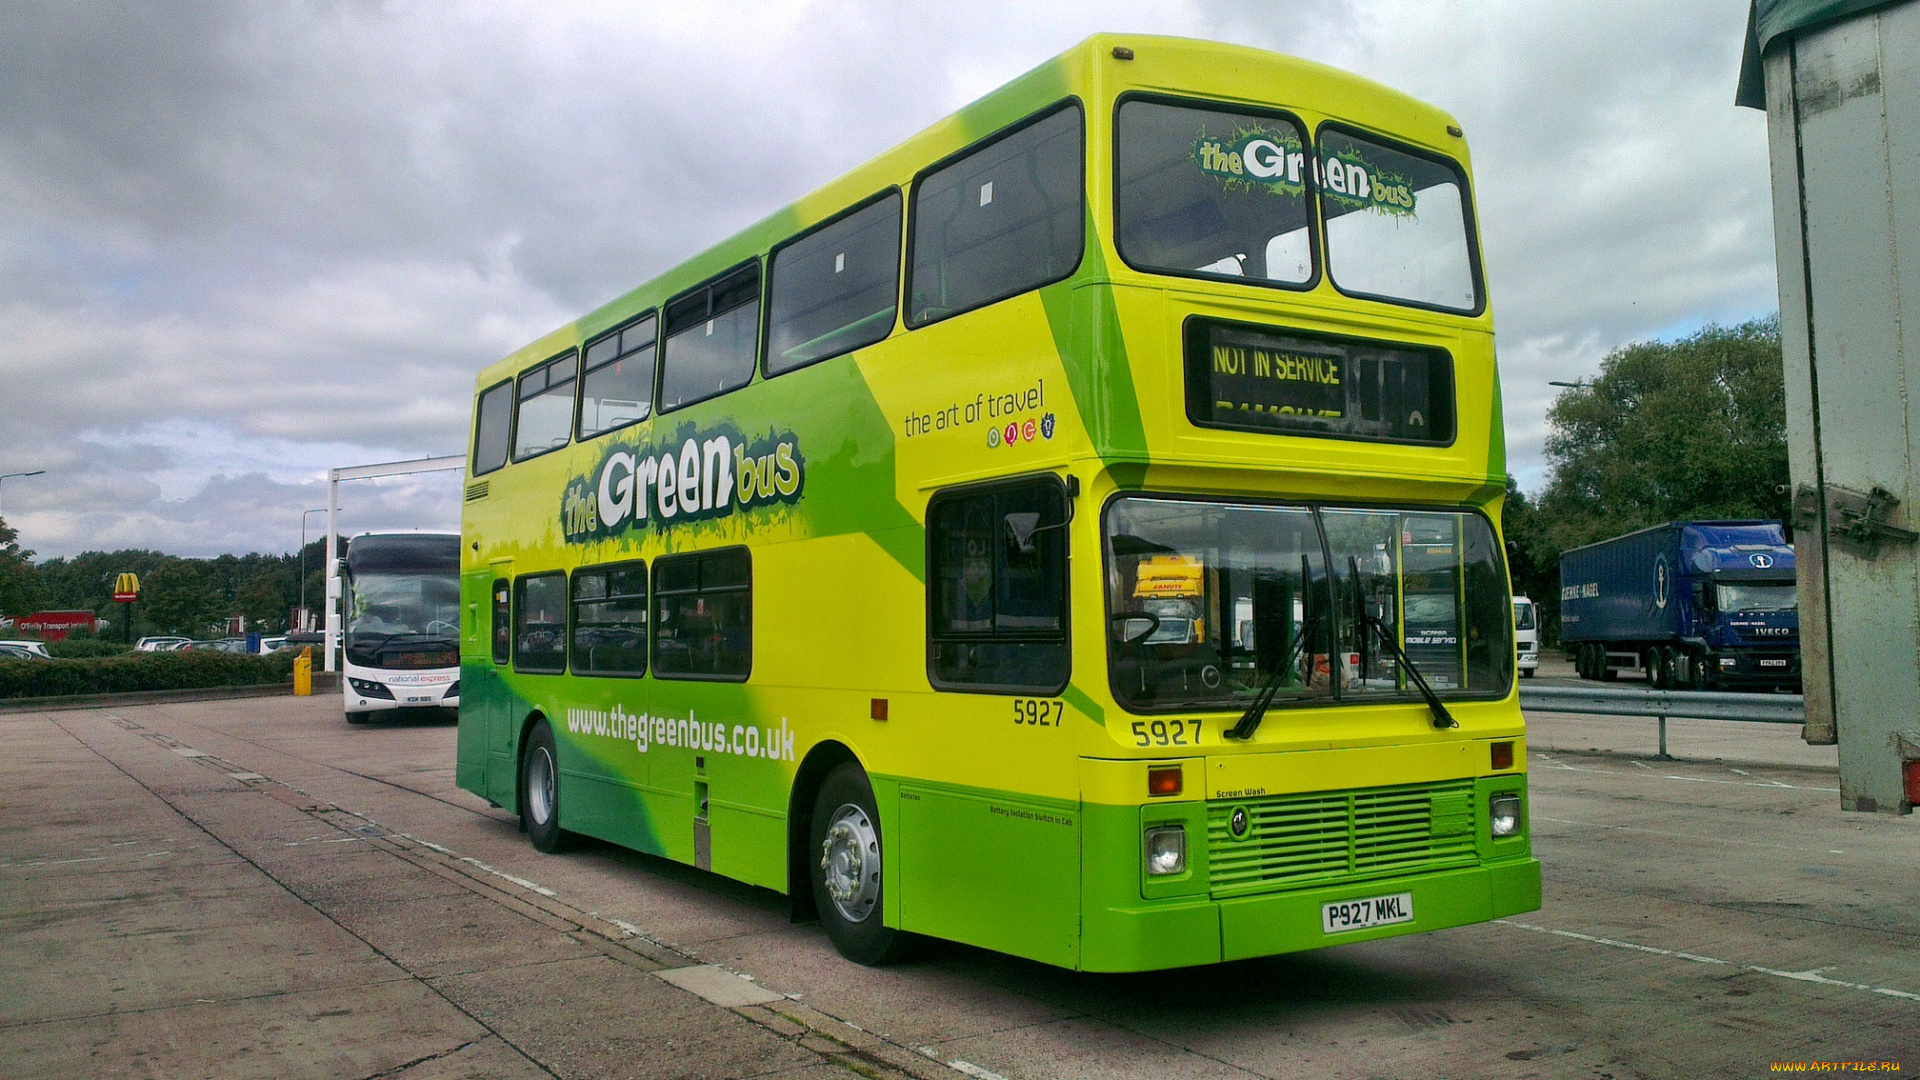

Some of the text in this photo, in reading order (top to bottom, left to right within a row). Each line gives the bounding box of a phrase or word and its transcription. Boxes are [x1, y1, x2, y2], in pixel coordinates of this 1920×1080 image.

[1200, 142, 1243, 175] the
[1370, 175, 1414, 208] bus
[1213, 346, 1340, 385] NOT IN SERVICE
[905, 379, 1044, 437] the art of travel
[566, 435, 800, 535] the Green bus
[43, 622, 69, 631] Transport
[1013, 699, 1064, 727] 5927
[567, 703, 796, 762] www.thegreenbus.co.uk
[1131, 719, 1203, 747] 5927
[1216, 787, 1266, 798] Screen Wash
[990, 806, 1010, 817] Battery
[1010, 809, 1034, 820] Isolation
[1034, 812, 1054, 823] Switch
[1328, 897, 1408, 927] P927 MKL
